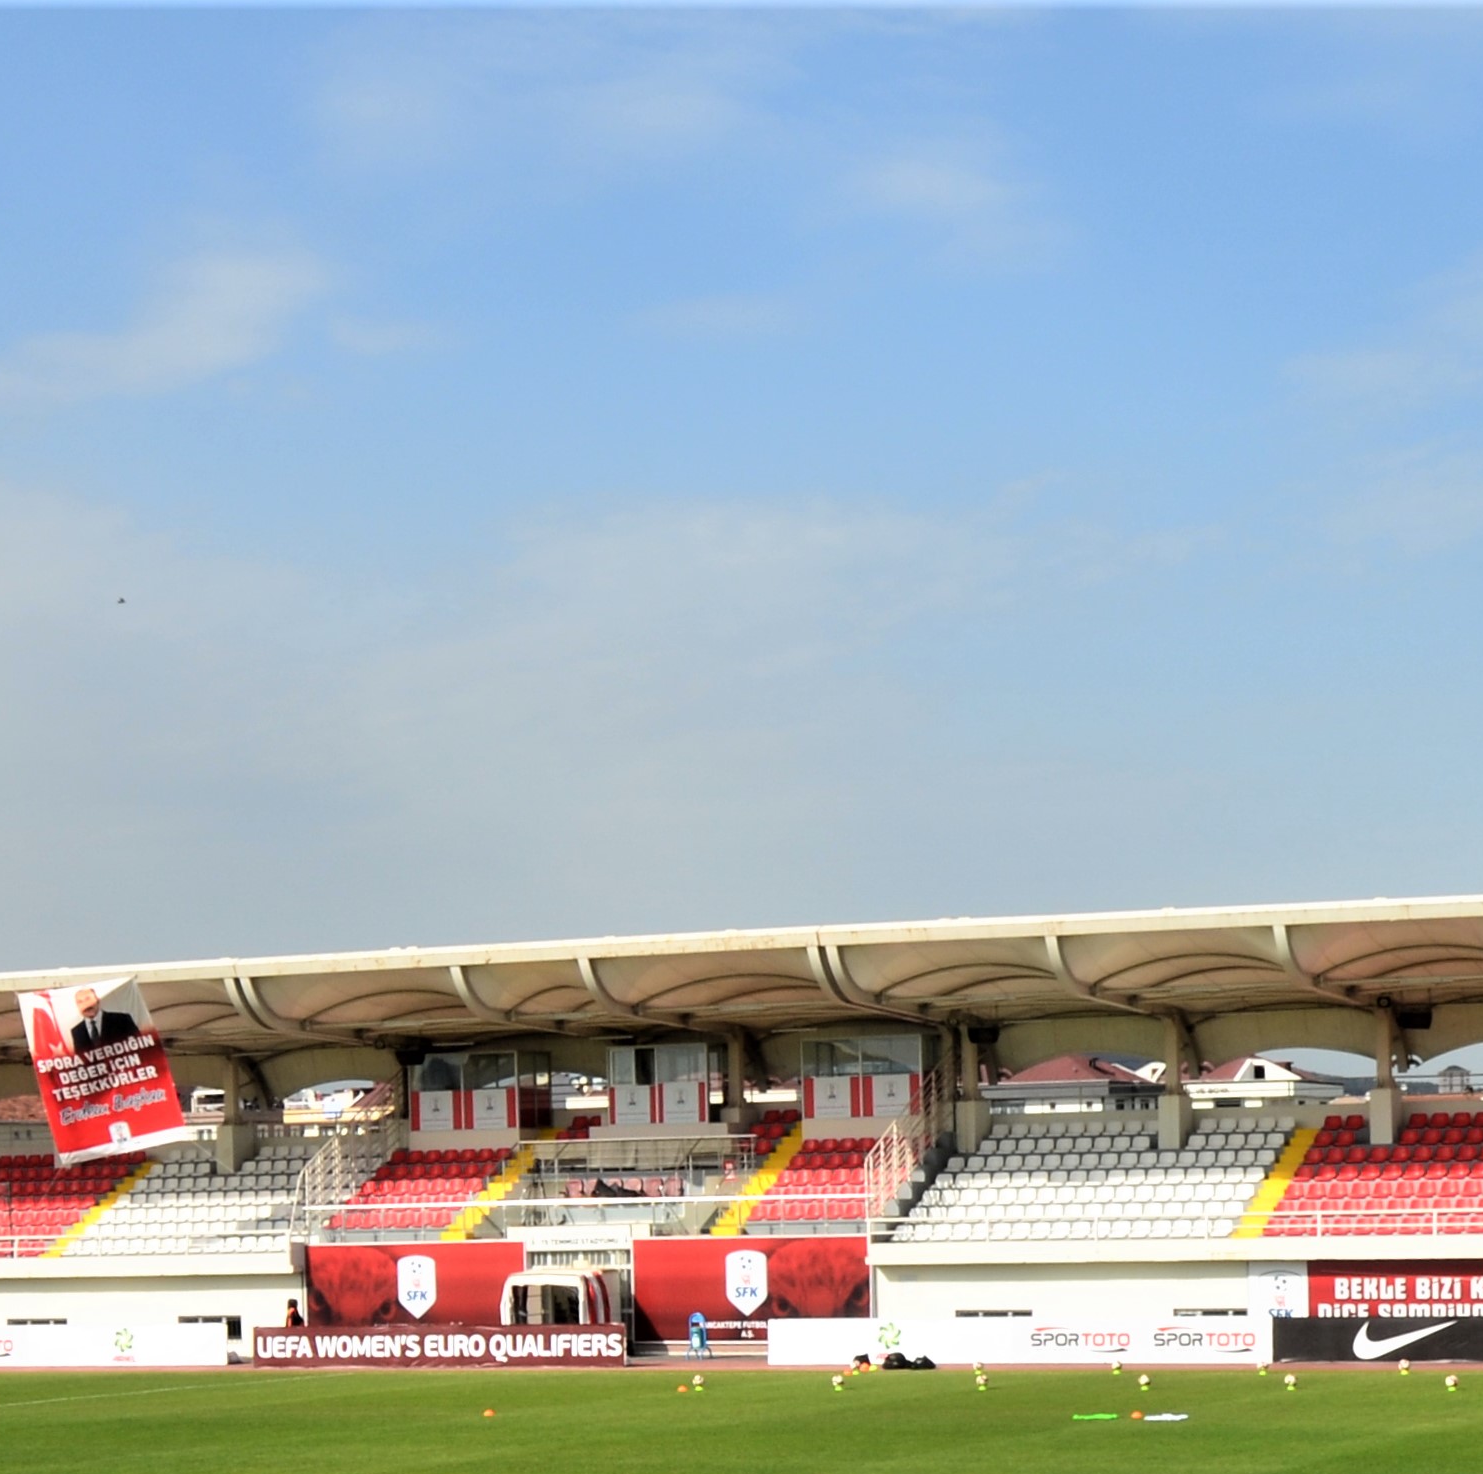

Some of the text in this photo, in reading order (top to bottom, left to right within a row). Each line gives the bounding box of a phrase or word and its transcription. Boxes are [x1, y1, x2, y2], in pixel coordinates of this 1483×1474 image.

[37, 1054, 84, 1074] SPORA
[59, 1062, 108, 1085] DEĞER
[52, 1065, 158, 1102] TEŞEKKÜRLER
[406, 1290, 428, 1301] SFK
[735, 1287, 758, 1297] SFK
[1334, 1277, 1408, 1300] BEKLE
[1415, 1277, 1462, 1300] BİZİ
[257, 1333, 623, 1362] UEFA WOMEN'S EURO QUALIFIERS
